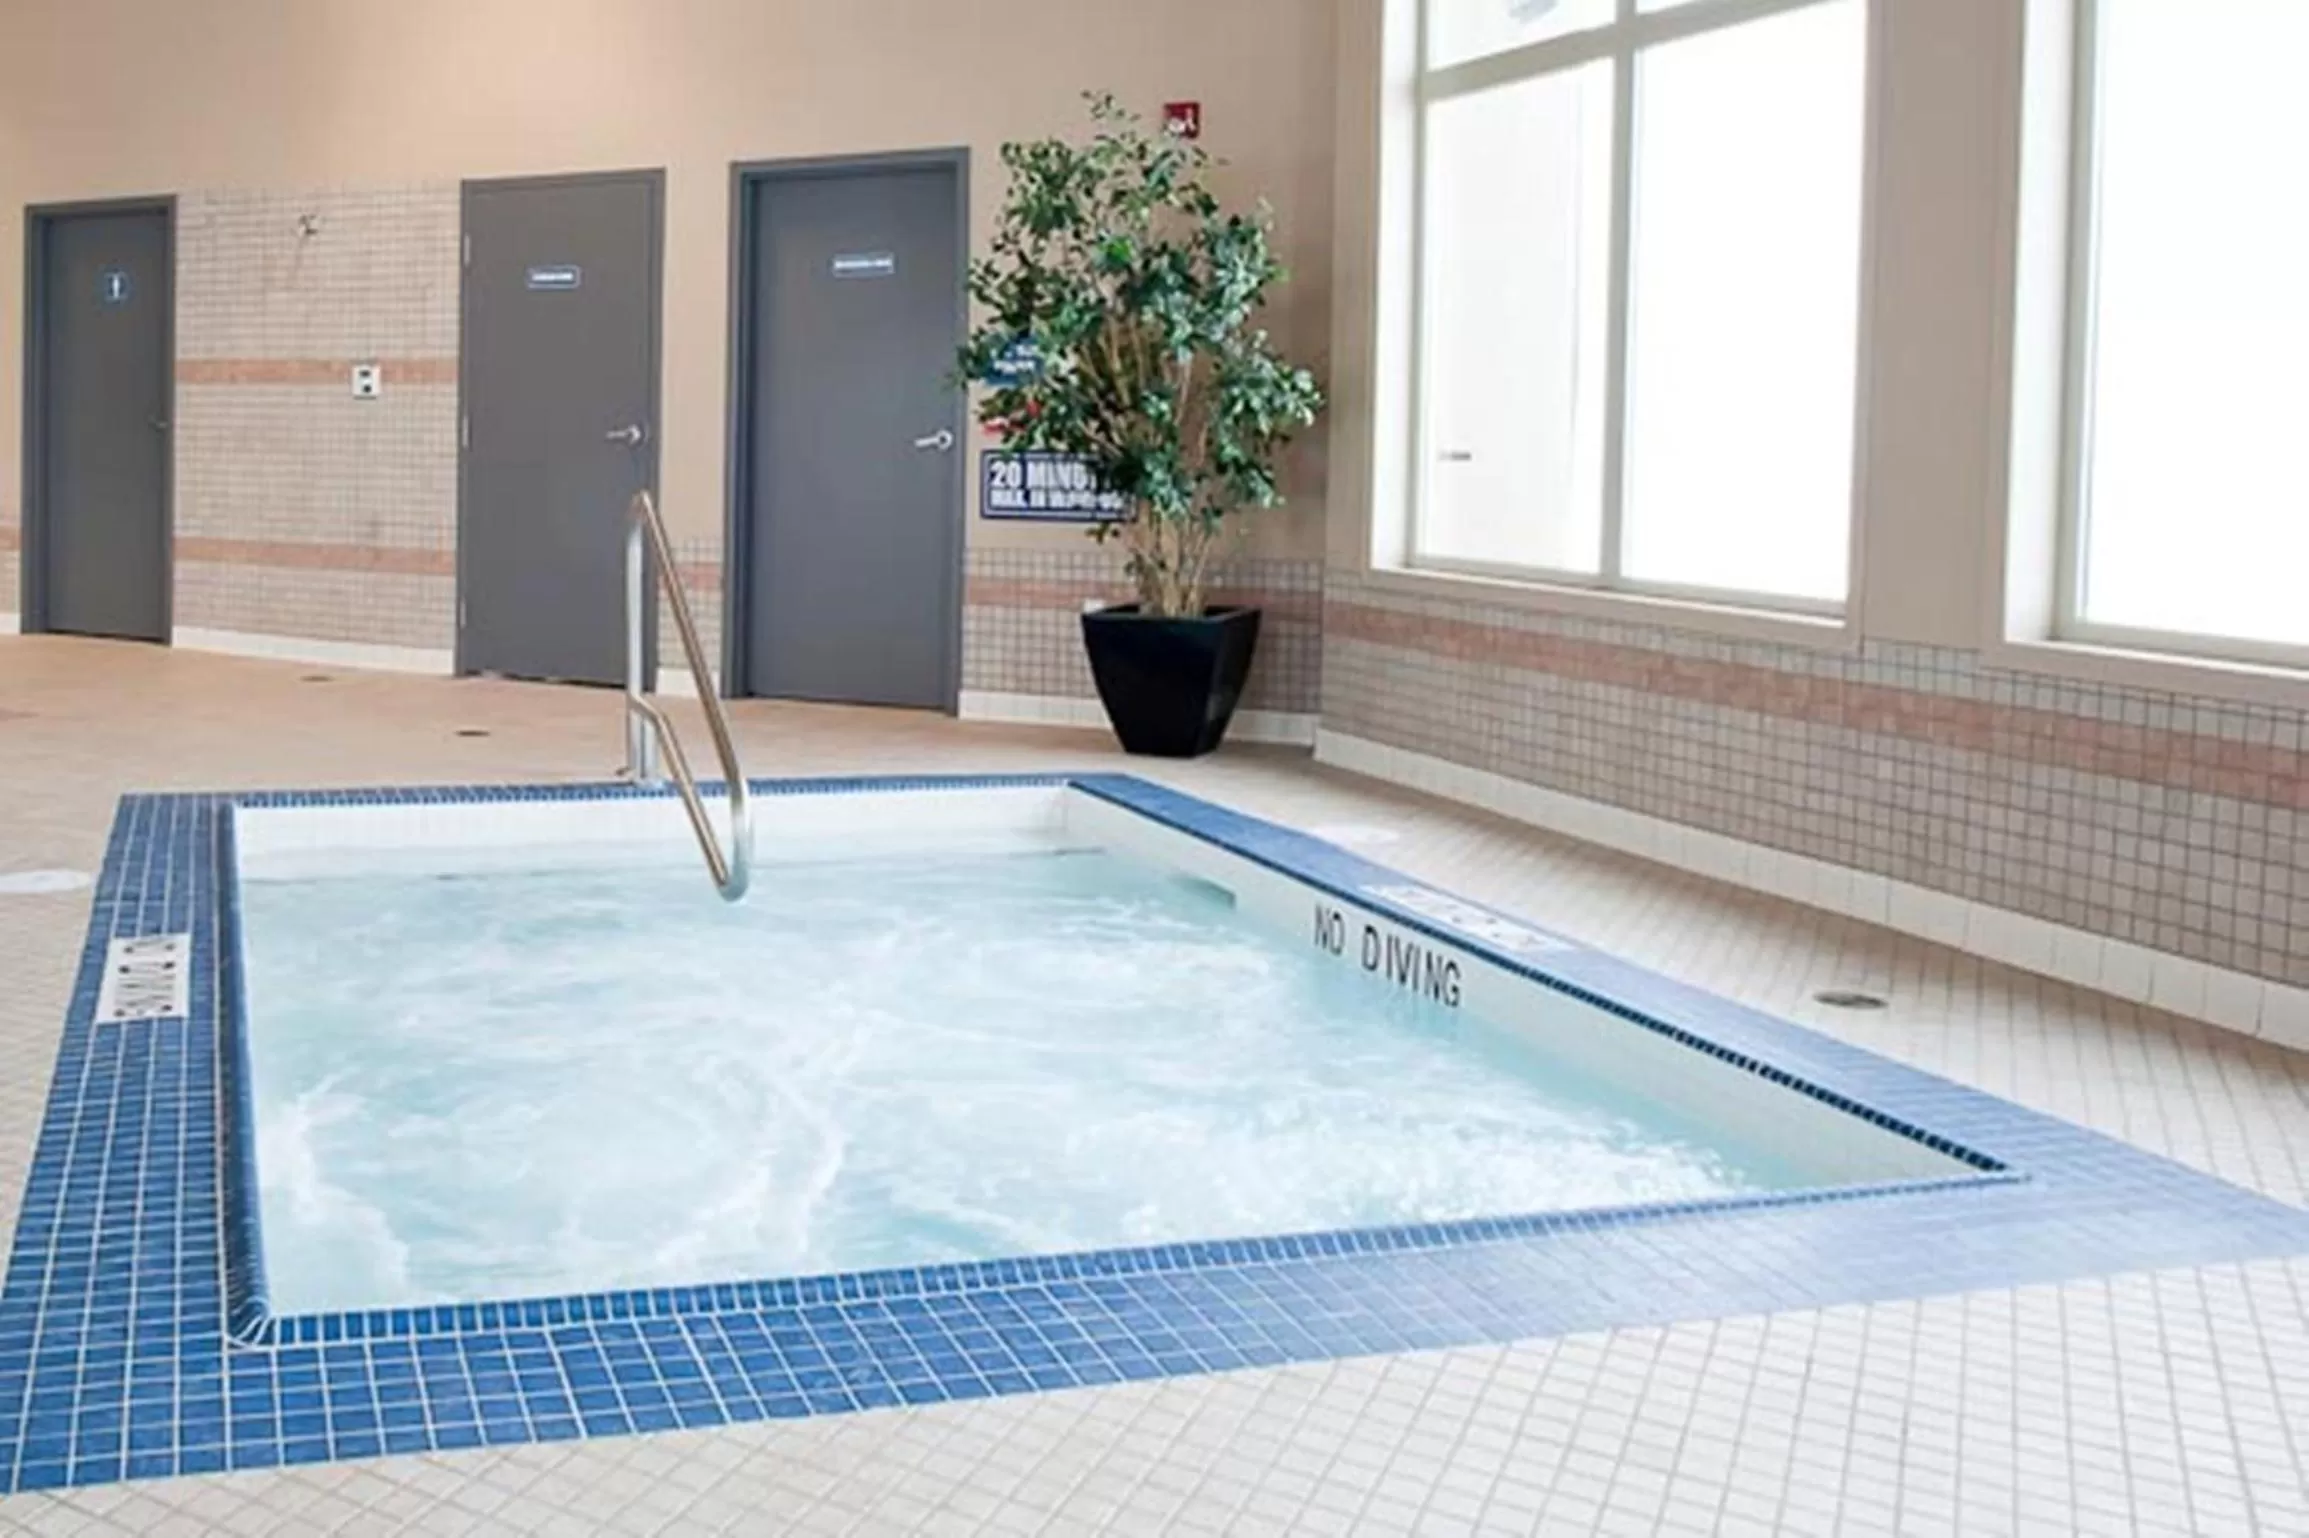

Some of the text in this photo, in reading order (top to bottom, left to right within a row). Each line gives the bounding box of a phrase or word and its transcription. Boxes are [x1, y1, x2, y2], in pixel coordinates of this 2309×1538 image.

[990, 460, 1099, 490] 20 MINU
[1314, 904, 1346, 956] NO
[1361, 924, 1461, 1008] DIVING
